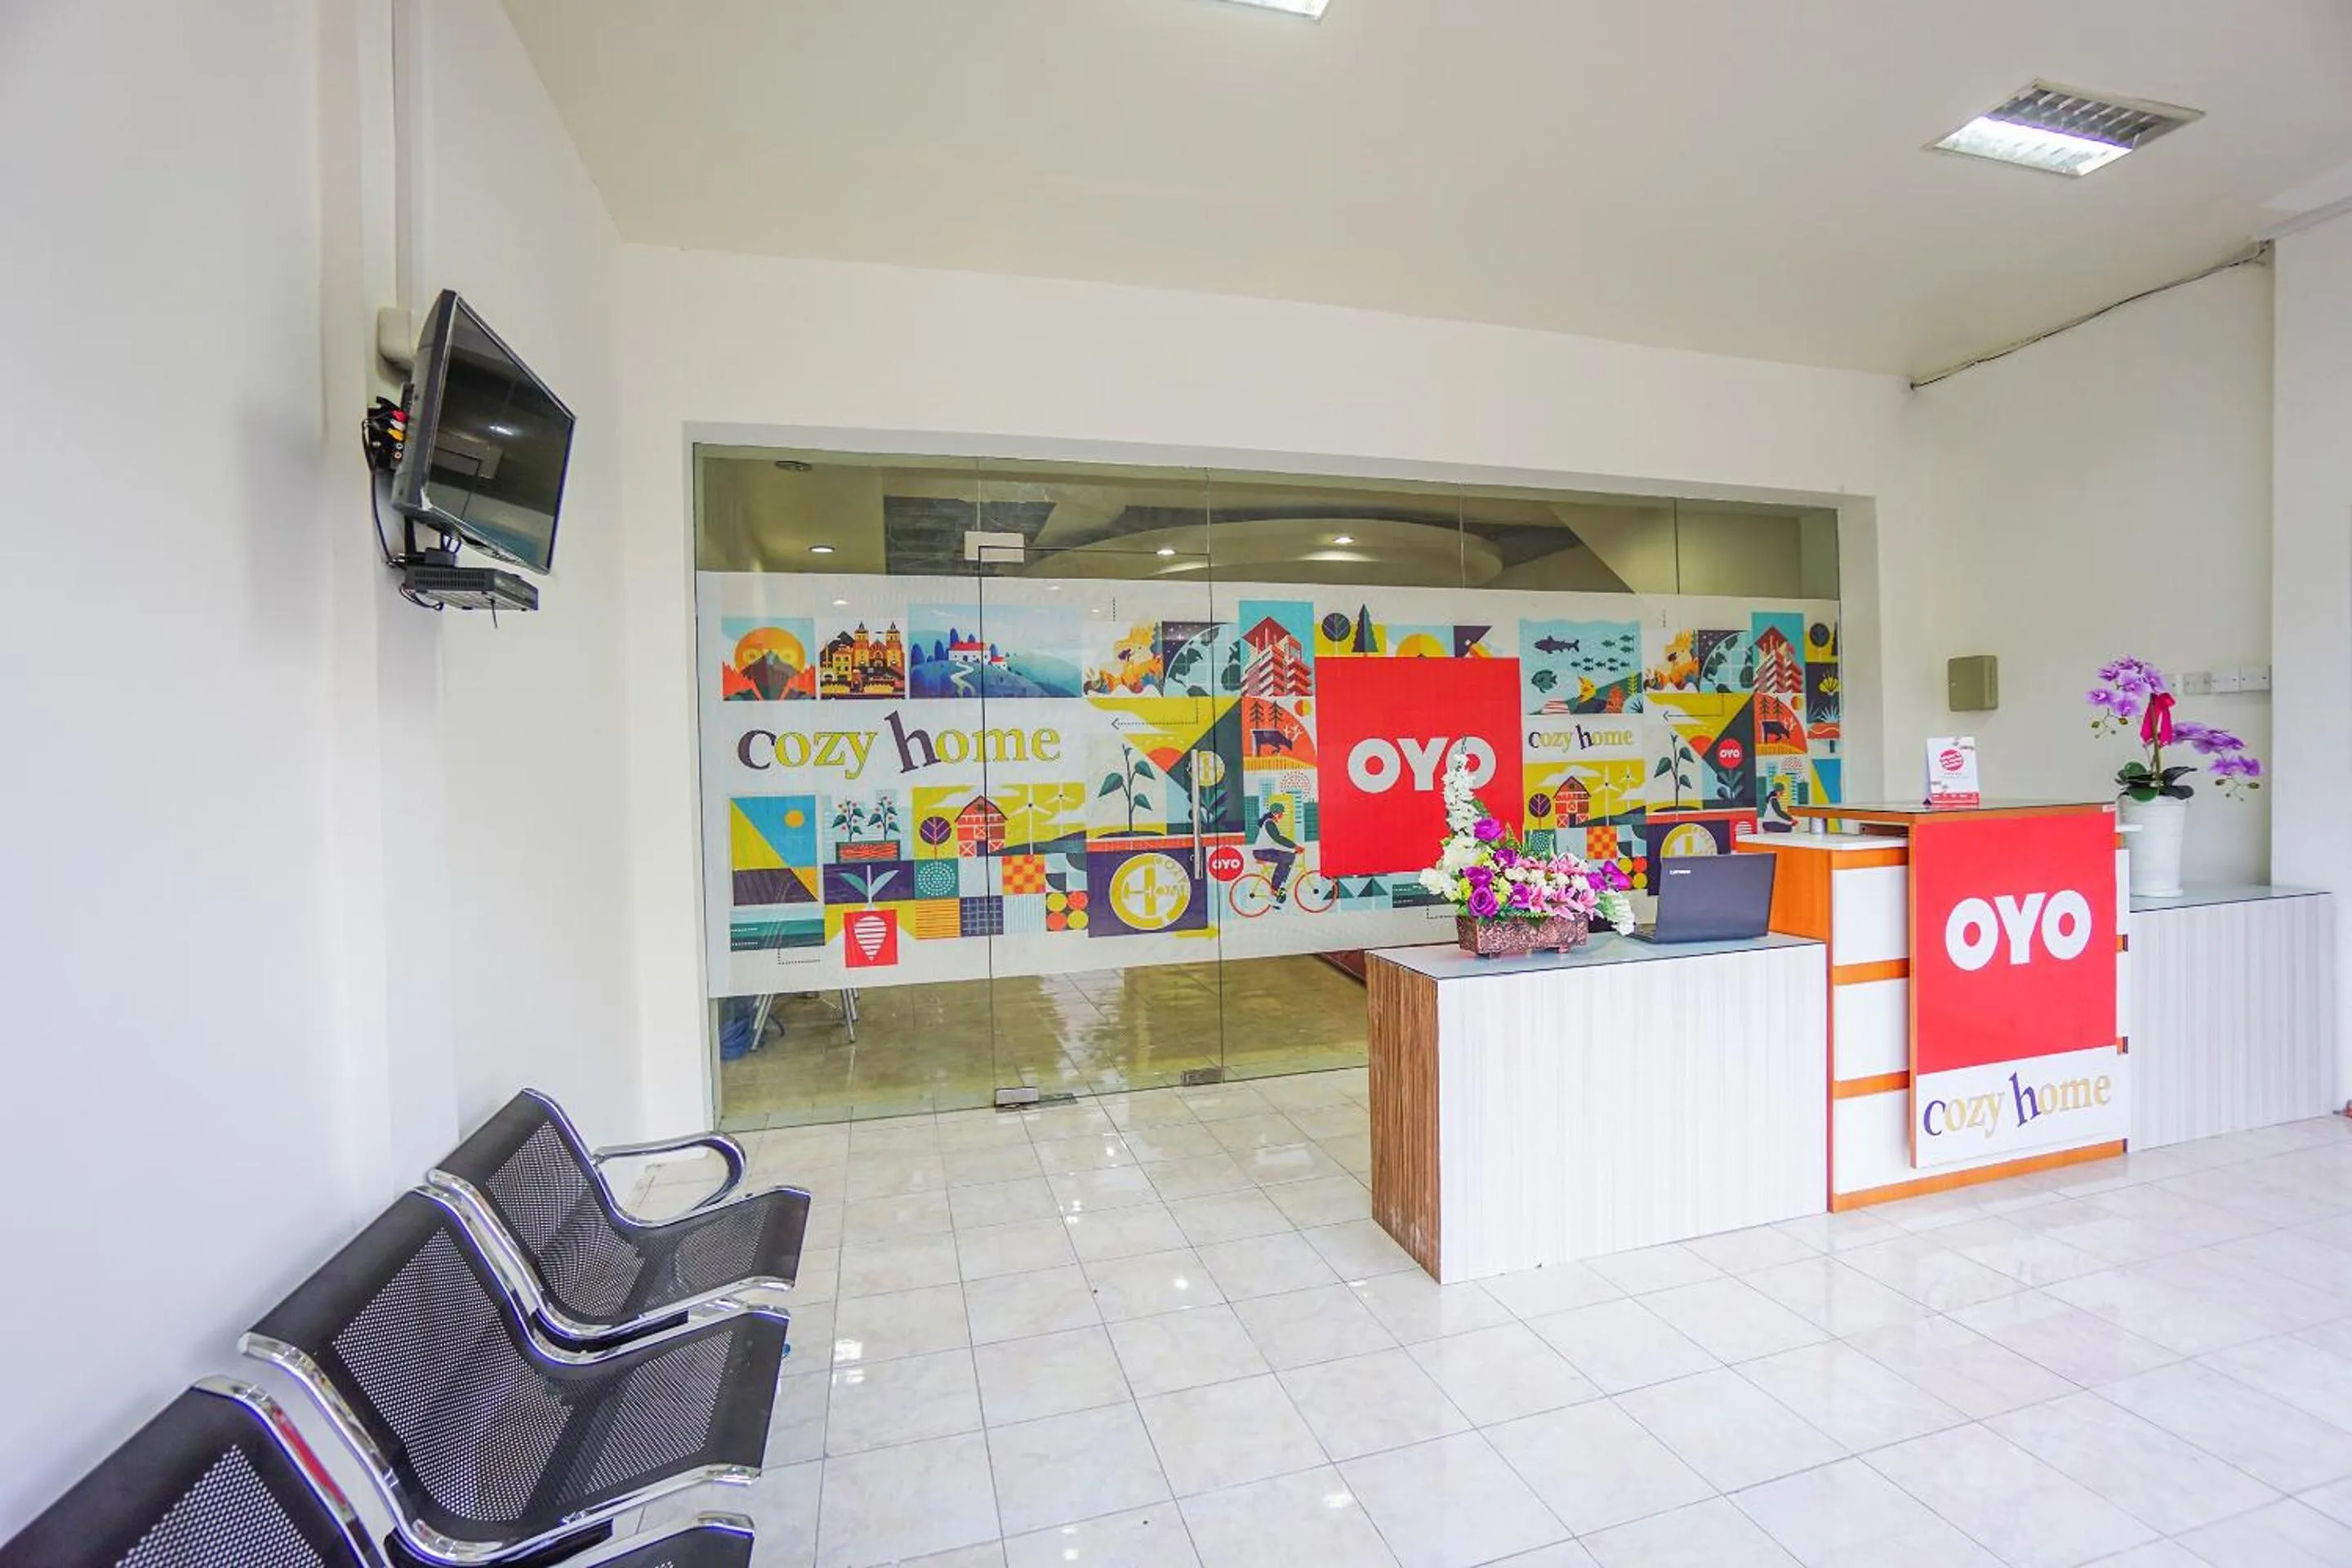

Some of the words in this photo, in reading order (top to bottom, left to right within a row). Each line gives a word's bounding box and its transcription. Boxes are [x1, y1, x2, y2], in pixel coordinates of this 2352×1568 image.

[737, 729, 878, 780] cozy
[884, 710, 1061, 773] home
[1348, 736, 1497, 793] OYO
[1528, 732, 1571, 753] cozy
[1575, 724, 1633, 750] home
[1719, 749, 1740, 759] OYO
[1212, 858, 1241, 870] OYO
[1945, 889, 2092, 971] OYO
[1923, 1092, 2006, 1139] cozy
[2008, 1071, 2112, 1128] home
